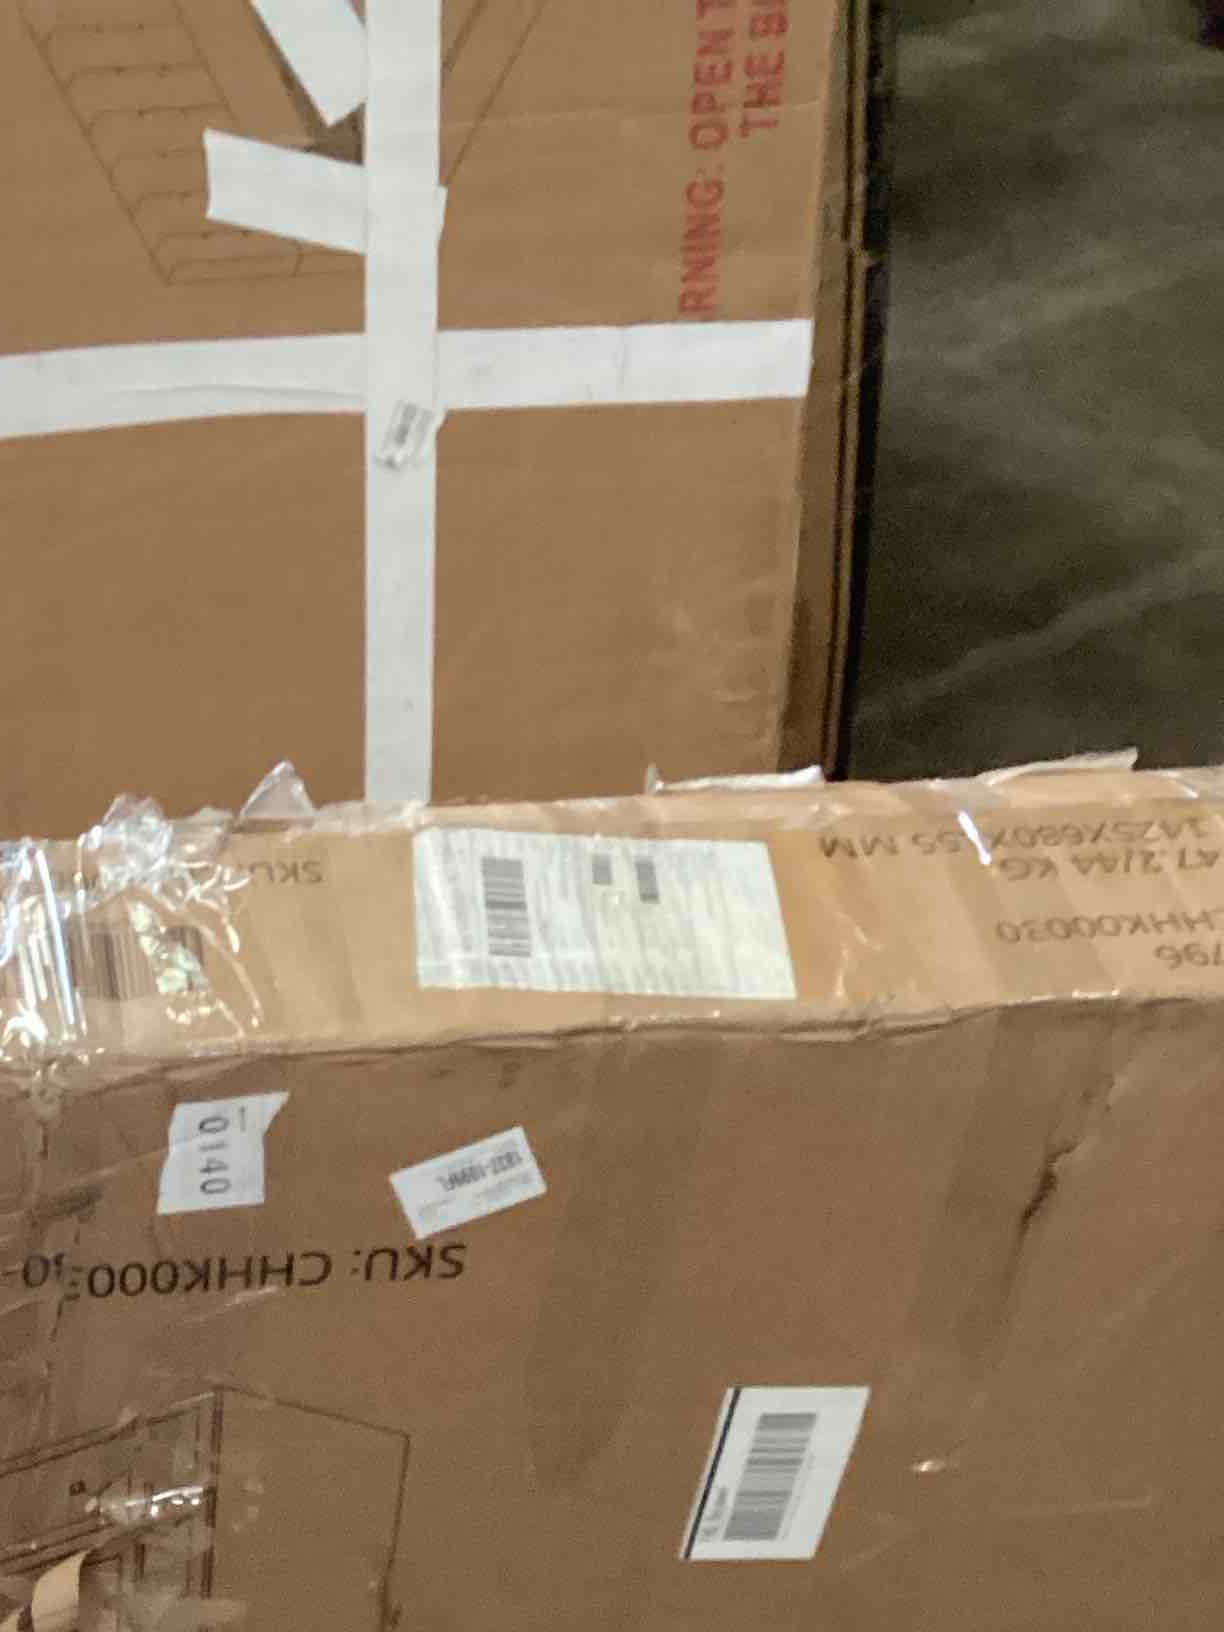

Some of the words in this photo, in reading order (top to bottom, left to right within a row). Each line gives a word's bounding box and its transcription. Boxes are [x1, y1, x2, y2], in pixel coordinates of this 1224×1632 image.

[747, 0, 789, 40] B
[689, 28, 734, 150] OPEN
[739, 50, 785, 139] THE
[817, 832, 901, 861] MM
[997, 857, 1060, 883] KG
[350, 1243, 468, 1284] SKU:
